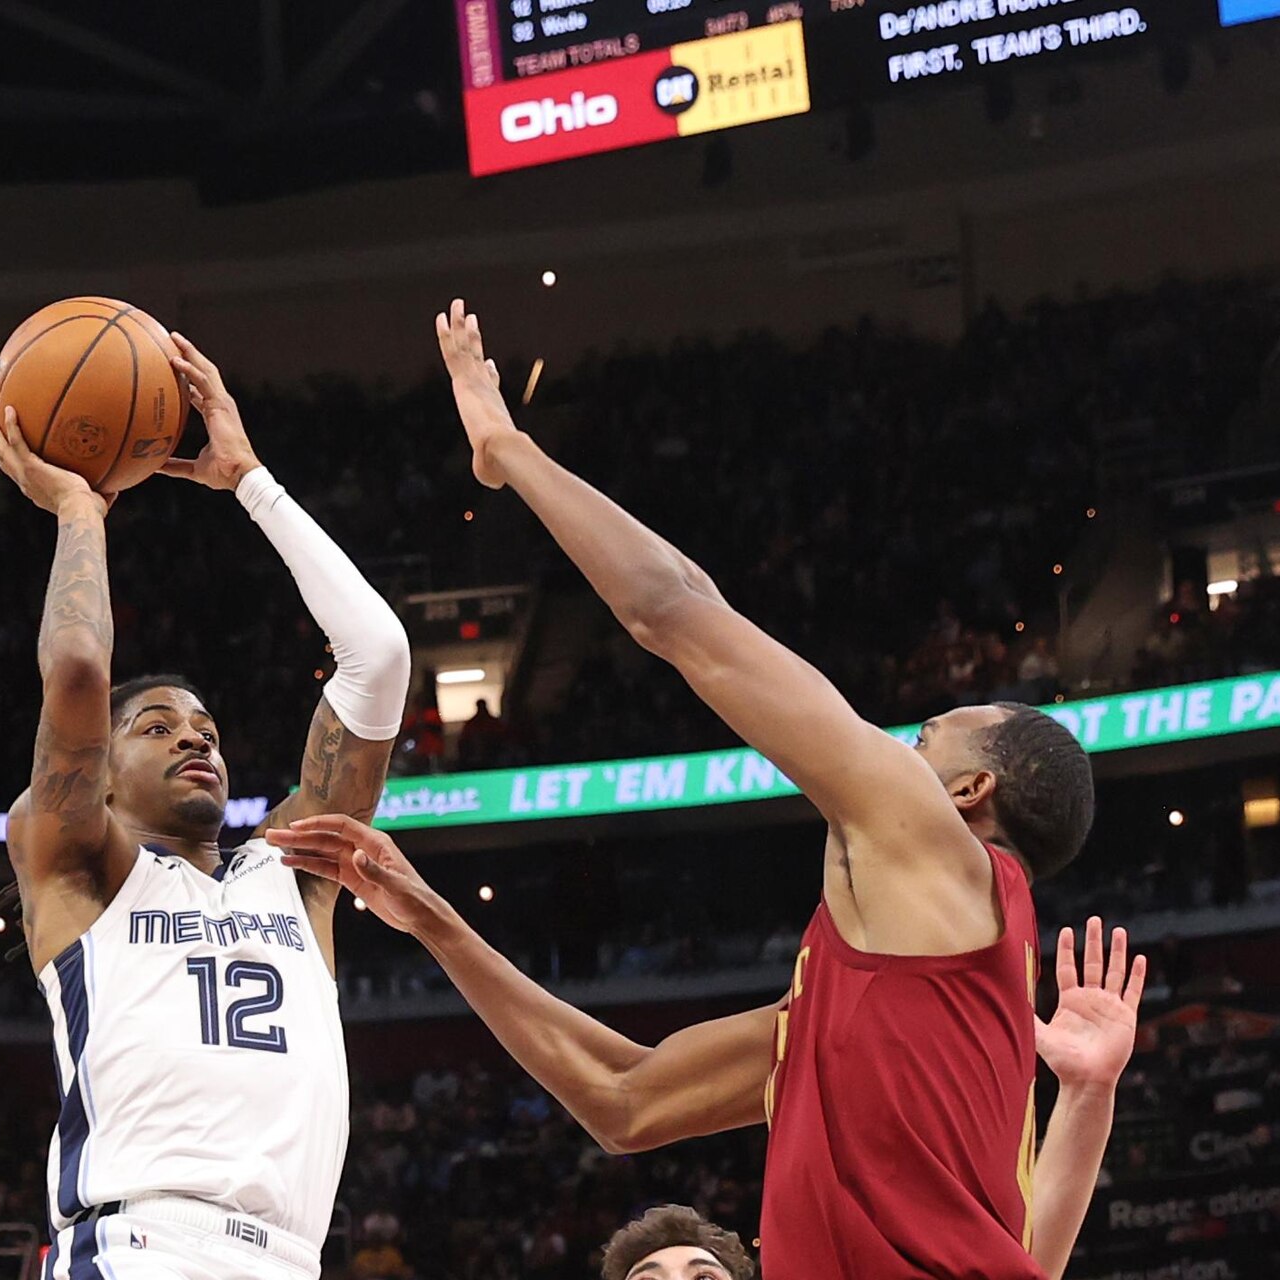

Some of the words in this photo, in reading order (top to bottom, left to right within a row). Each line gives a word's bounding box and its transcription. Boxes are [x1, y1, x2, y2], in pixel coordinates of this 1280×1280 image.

[513, 50, 567, 77] TEAM
[567, 33, 640, 65] TOTALS
[888, 44, 964, 82] FIRST.
[971, 23, 1062, 64] TEAM'S
[1063, 8, 1147, 46] THIRD.
[500, 91, 618, 143] Ohio
[1121, 689, 1214, 739] THE
[510, 767, 591, 813] LET
[128, 909, 305, 952] MEMPHIS
[186, 956, 288, 1054] 12
